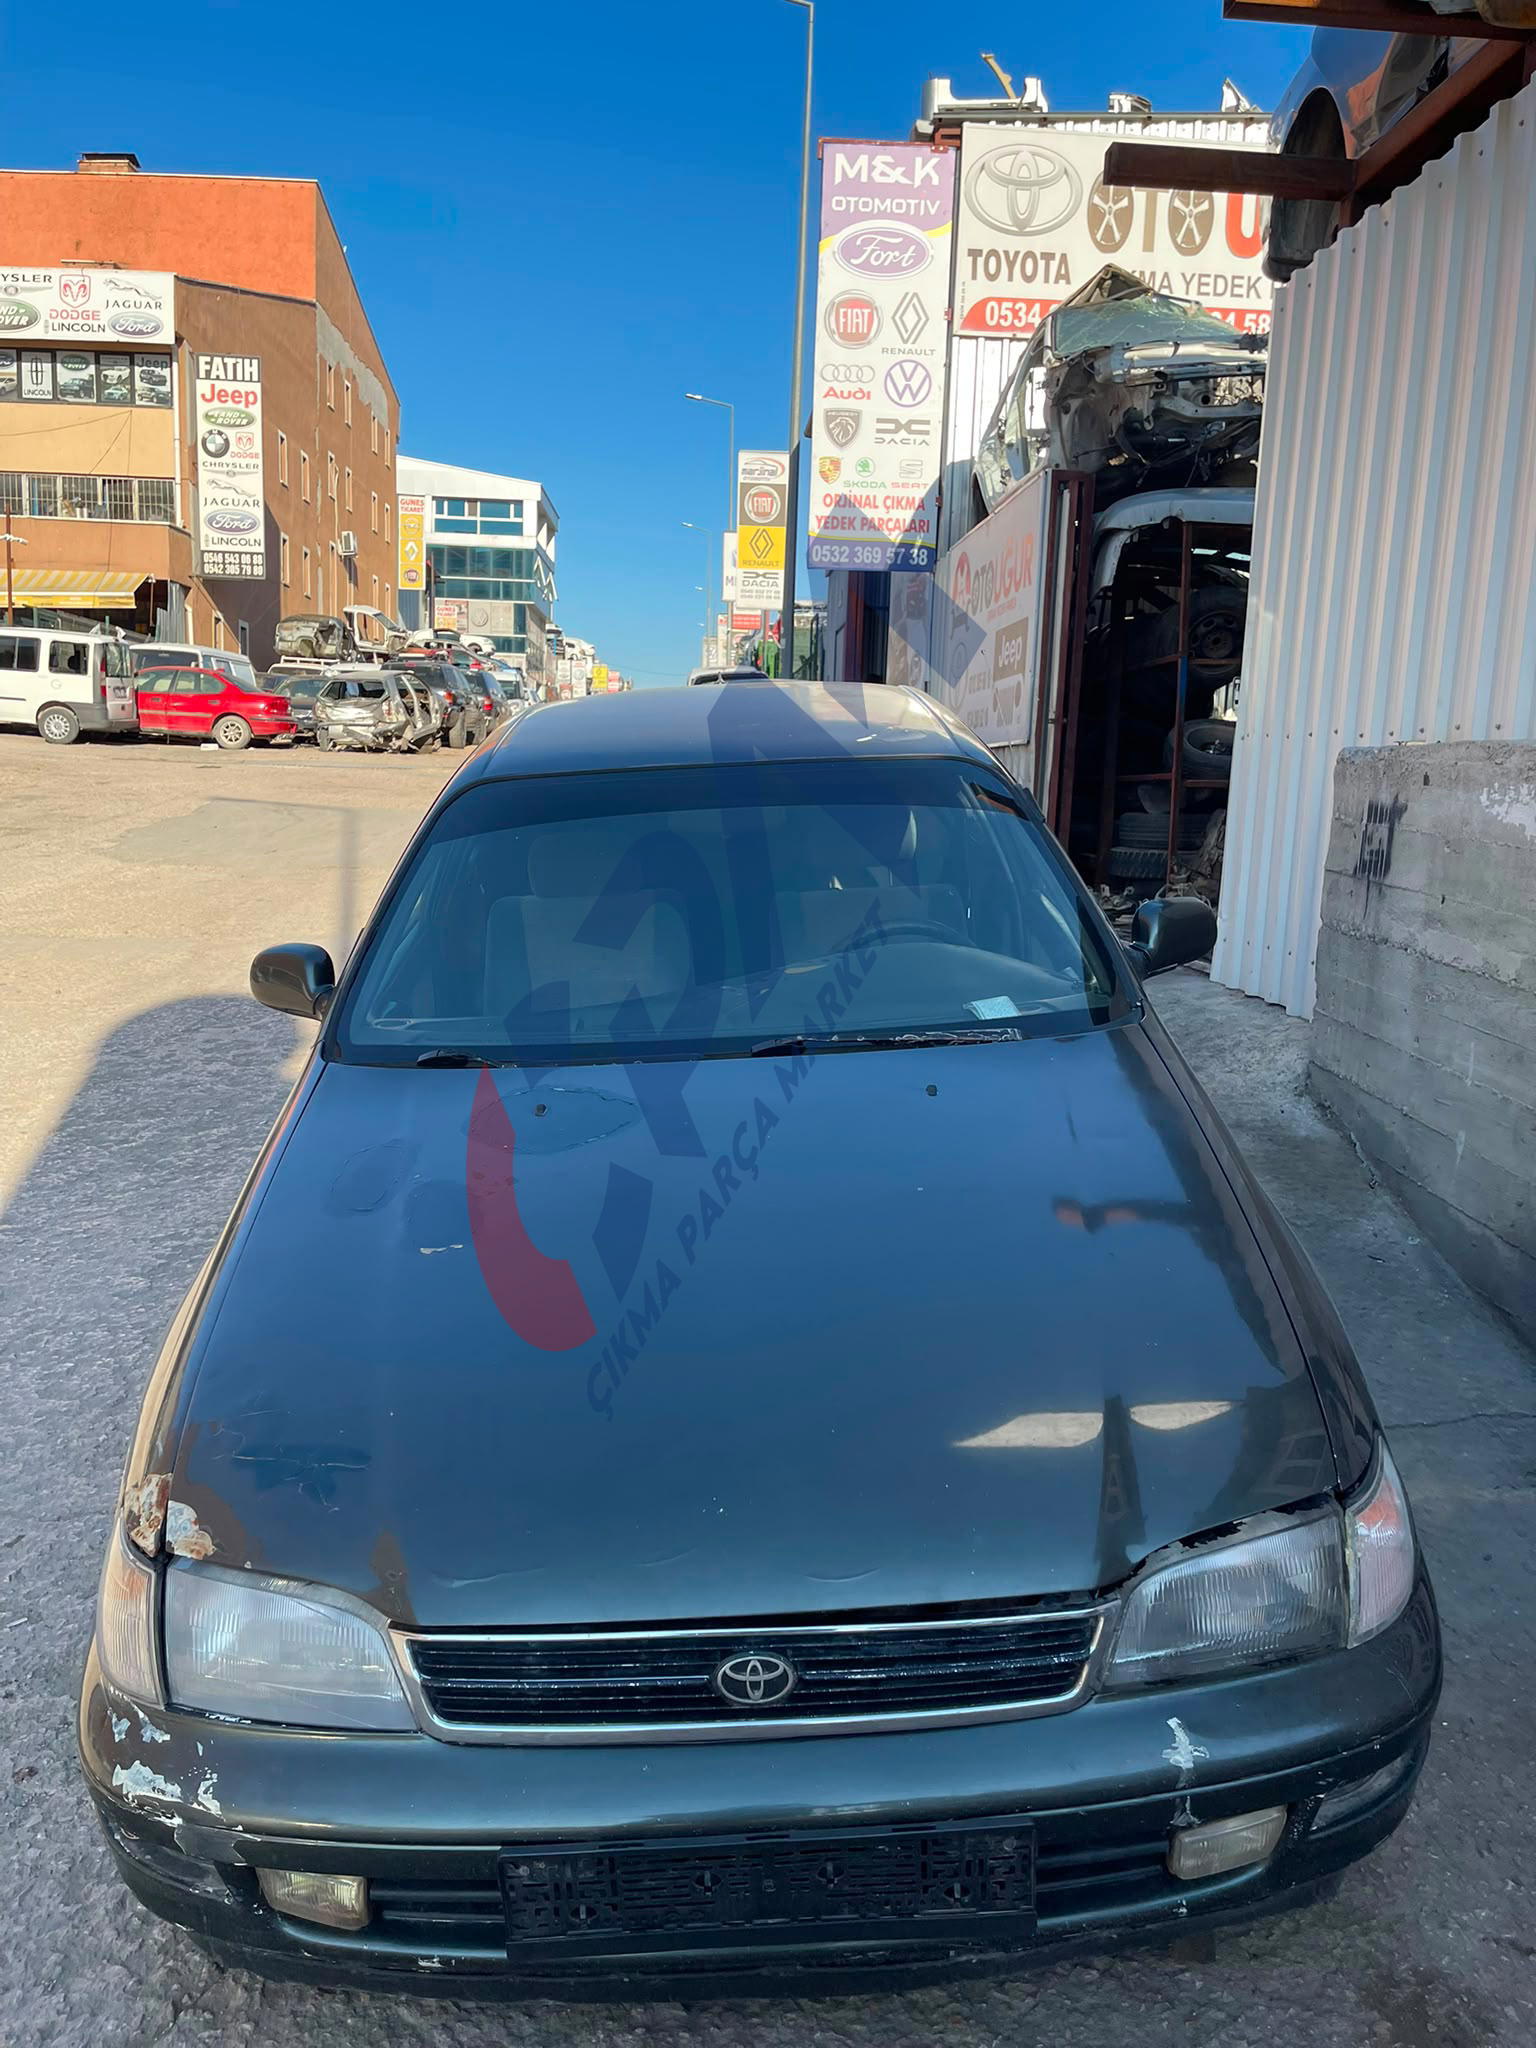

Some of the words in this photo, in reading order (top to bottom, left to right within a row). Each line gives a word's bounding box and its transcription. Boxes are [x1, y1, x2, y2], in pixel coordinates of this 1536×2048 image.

[834, 153, 941, 188] M&K
[967, 248, 1072, 285] TOYOTA
[1181, 272, 1263, 299] YEDEK
[49, 308, 101, 321] DODGE
[105, 299, 163, 311] JAGUAR
[985, 301, 1041, 328] 0534
[51, 321, 106, 333] LINCOLN
[838, 307, 872, 334] FIAT
[881, 347, 936, 357] RENAULT
[200, 383, 258, 409] Jeep
[230, 451, 260, 459] DODGE
[202, 460, 260, 470] CHRYSLER
[203, 497, 260, 508] JAGUAR
[883, 495, 926, 514] ÇIKMA
[815, 514, 860, 530] YEDEK
[860, 516, 931, 536] PARÇALARI
[211, 536, 262, 547] LINCOLN
[811, 544, 850, 563] 0532
[853, 546, 881, 565] 369
[886, 547, 905, 565] 57
[908, 549, 928, 566] 38
[742, 580, 779, 588] DACIA
[998, 635, 1024, 671] Jeep
